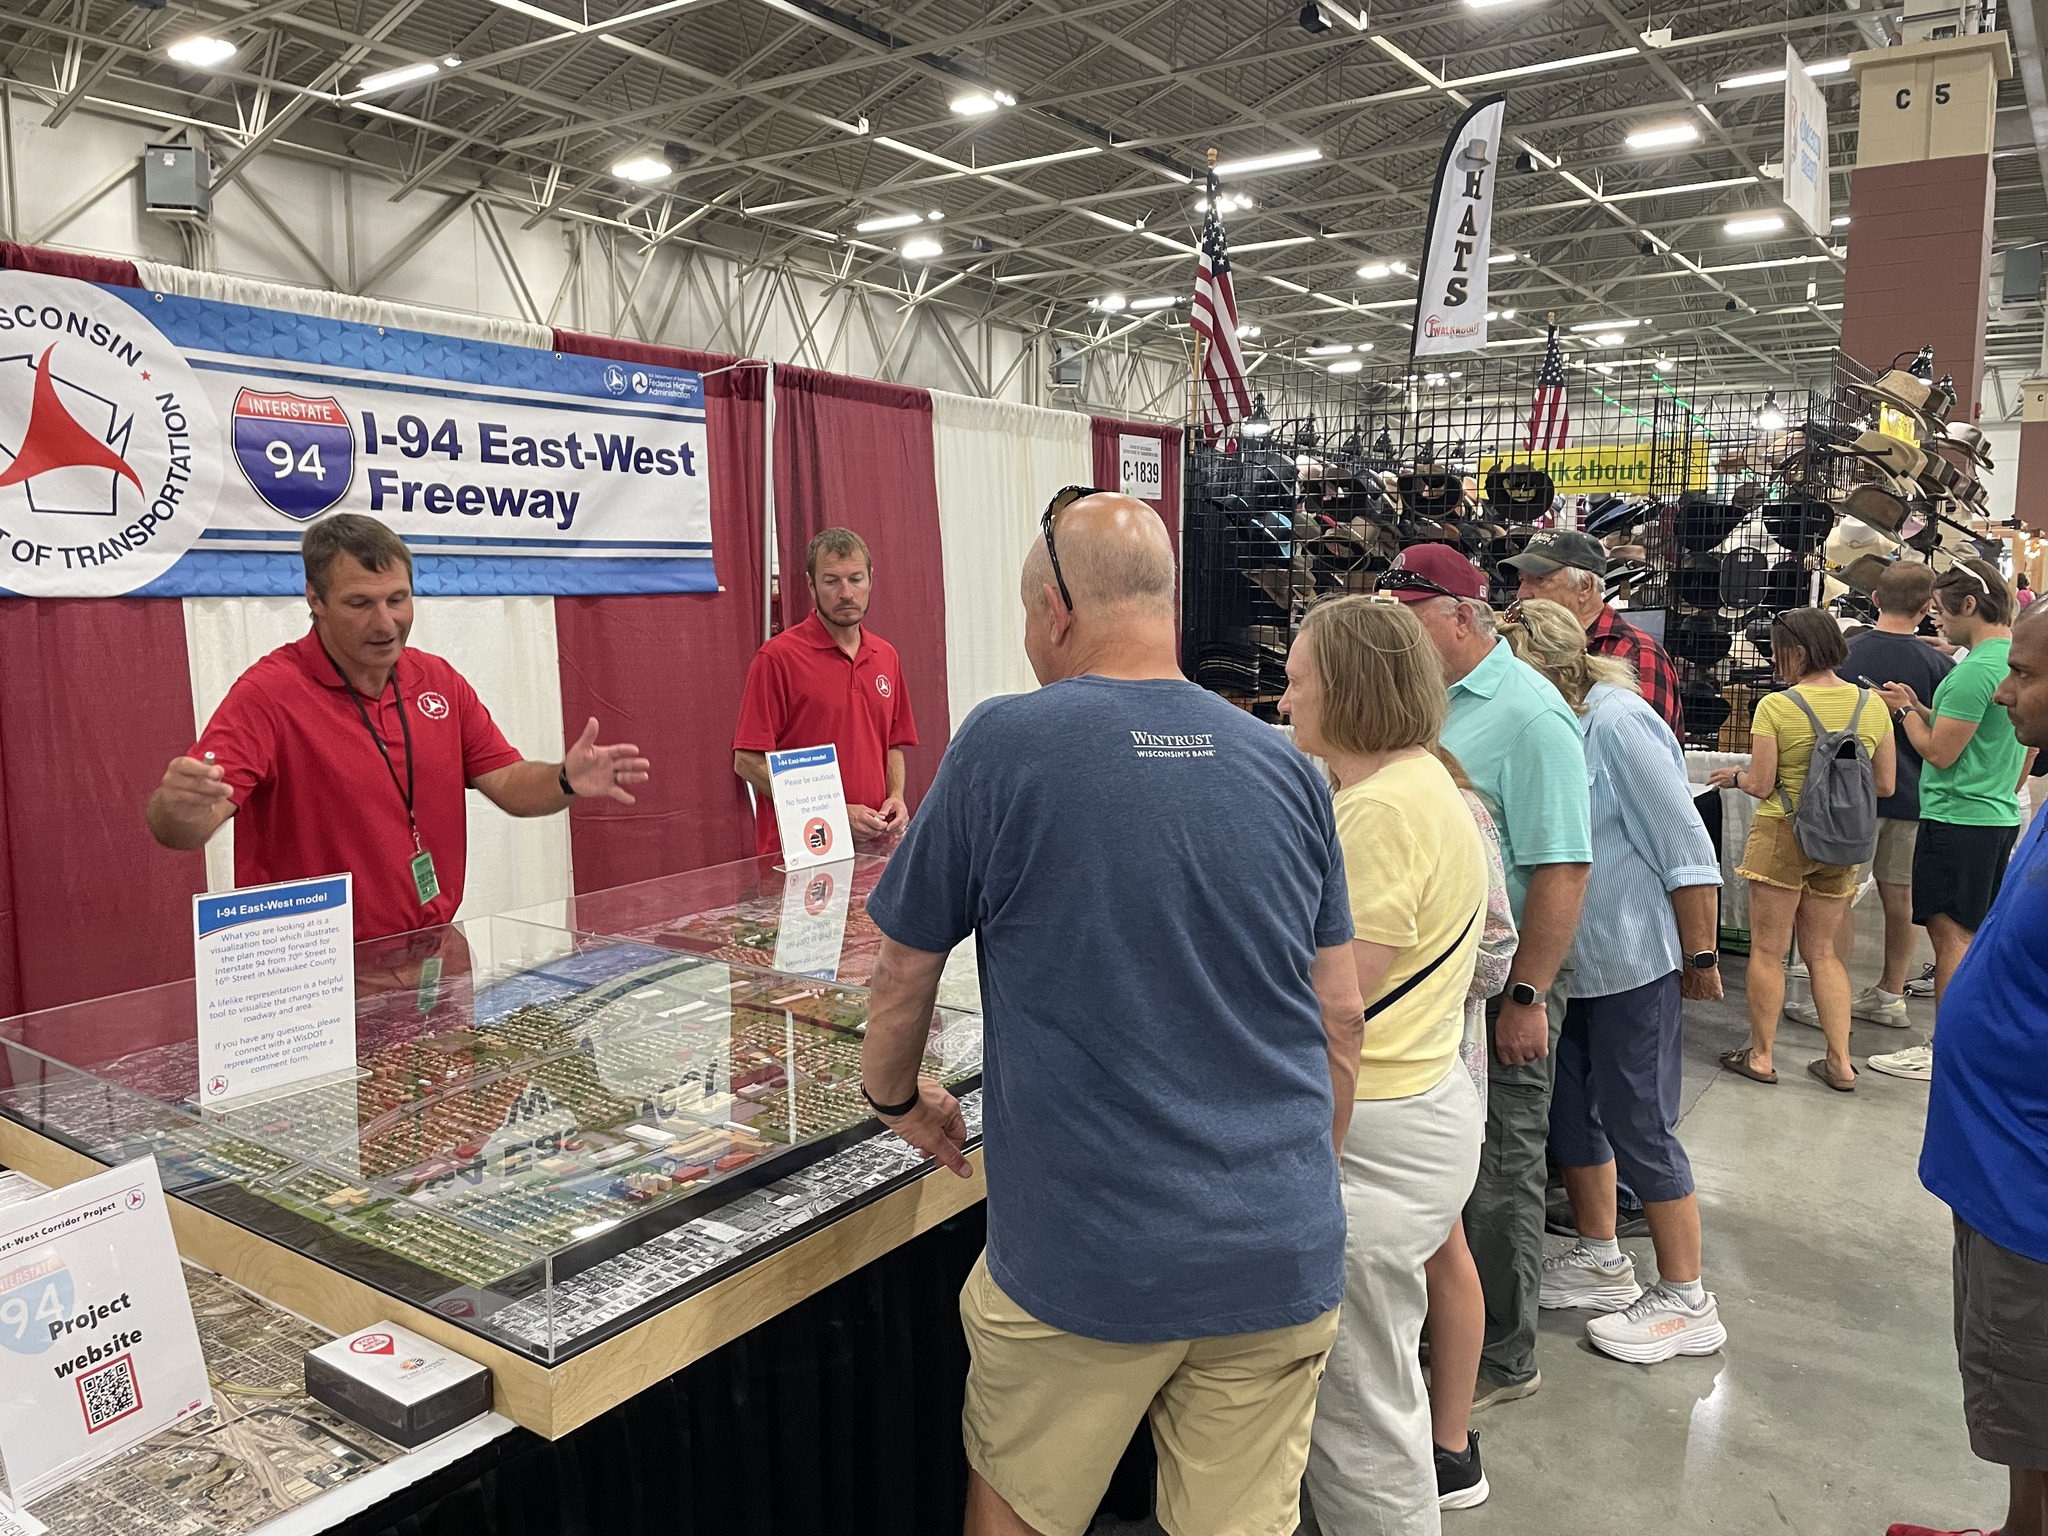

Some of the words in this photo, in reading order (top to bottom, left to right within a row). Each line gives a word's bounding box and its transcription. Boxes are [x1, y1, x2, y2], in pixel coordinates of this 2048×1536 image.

[1896, 88, 1911, 110] C
[1935, 82, 1951, 104] 5
[1443, 169, 1484, 307] HATS
[648, 379, 672, 388] Federal
[673, 382, 698, 392] Highway
[648, 388, 690, 398] Administration
[2037, 394, 2044, 402] C
[248, 397, 333, 421] INTERSTATE
[362, 412, 462, 460] I-94
[478, 422, 696, 477] East-West
[264, 440, 326, 481] 94
[11, 539, 52, 566] OF
[58, 392, 192, 569] TRANSPORTATION
[367, 468, 580, 531] Freeway
[812, 754, 826, 762] model
[1136, 750, 1190, 758] WISCONSIN'S
[784, 778, 802, 786] Please
[812, 772, 835, 782] cautious
[786, 798, 795, 807] No
[796, 796, 809, 805] food
[818, 792, 832, 801] drink
[812, 802, 829, 812] model
[216, 906, 237, 918] I-94
[240, 898, 293, 915] East-West
[296, 892, 327, 905] model
[210, 942, 260, 954] visualization
[262, 936, 278, 946] tool
[280, 932, 302, 942] which
[304, 927, 340, 938] illustrates
[221, 932, 243, 941] What
[245, 931, 260, 940] you
[277, 922, 305, 932] looking
[215, 963, 253, 975] Interstate
[255, 960, 265, 968] 94
[268, 957, 286, 965] from
[289, 952, 303, 961] 70th
[304, 948, 326, 958] Street
[222, 956, 235, 964] the
[237, 952, 254, 962] plan
[256, 946, 286, 957] moving
[288, 940, 317, 951] forward
[215, 976, 230, 986] 16th
[232, 972, 255, 983] Street
[267, 963, 308, 976] Milwaukee
[310, 957, 337, 968] County
[210, 1010, 226, 1019] tool
[239, 1002, 272, 1013] visualize
[274, 998, 286, 1006] the
[289, 991, 320, 1003] changes
[332, 985, 344, 993] the
[218, 996, 244, 1007] lifelike
[246, 984, 302, 1001] representation
[318, 975, 344, 986] helpful
[244, 1011, 277, 1023] roadway
[279, 1006, 293, 1015] and
[222, 1041, 238, 1051] you
[240, 1036, 259, 1044] have
[261, 1032, 275, 1040] any
[276, 1023, 315, 1037] questions,
[317, 1016, 340, 1028] please
[234, 1044, 266, 1057] connect
[268, 1040, 284, 1049] with
[293, 1029, 323, 1043] WisDOT
[224, 1052, 280, 1069] representative
[292, 1041, 327, 1054] complete
[250, 1060, 287, 1073] comment
[0, 1232, 39, 1252] st-West
[41, 1216, 81, 1235] Corridor
[83, 1202, 116, 1220] Project
[1, 1283, 64, 1340] 94
[48, 1292, 131, 1341] Project
[1648, 1317, 1686, 1337] HOKA
[54, 1328, 143, 1379] website
